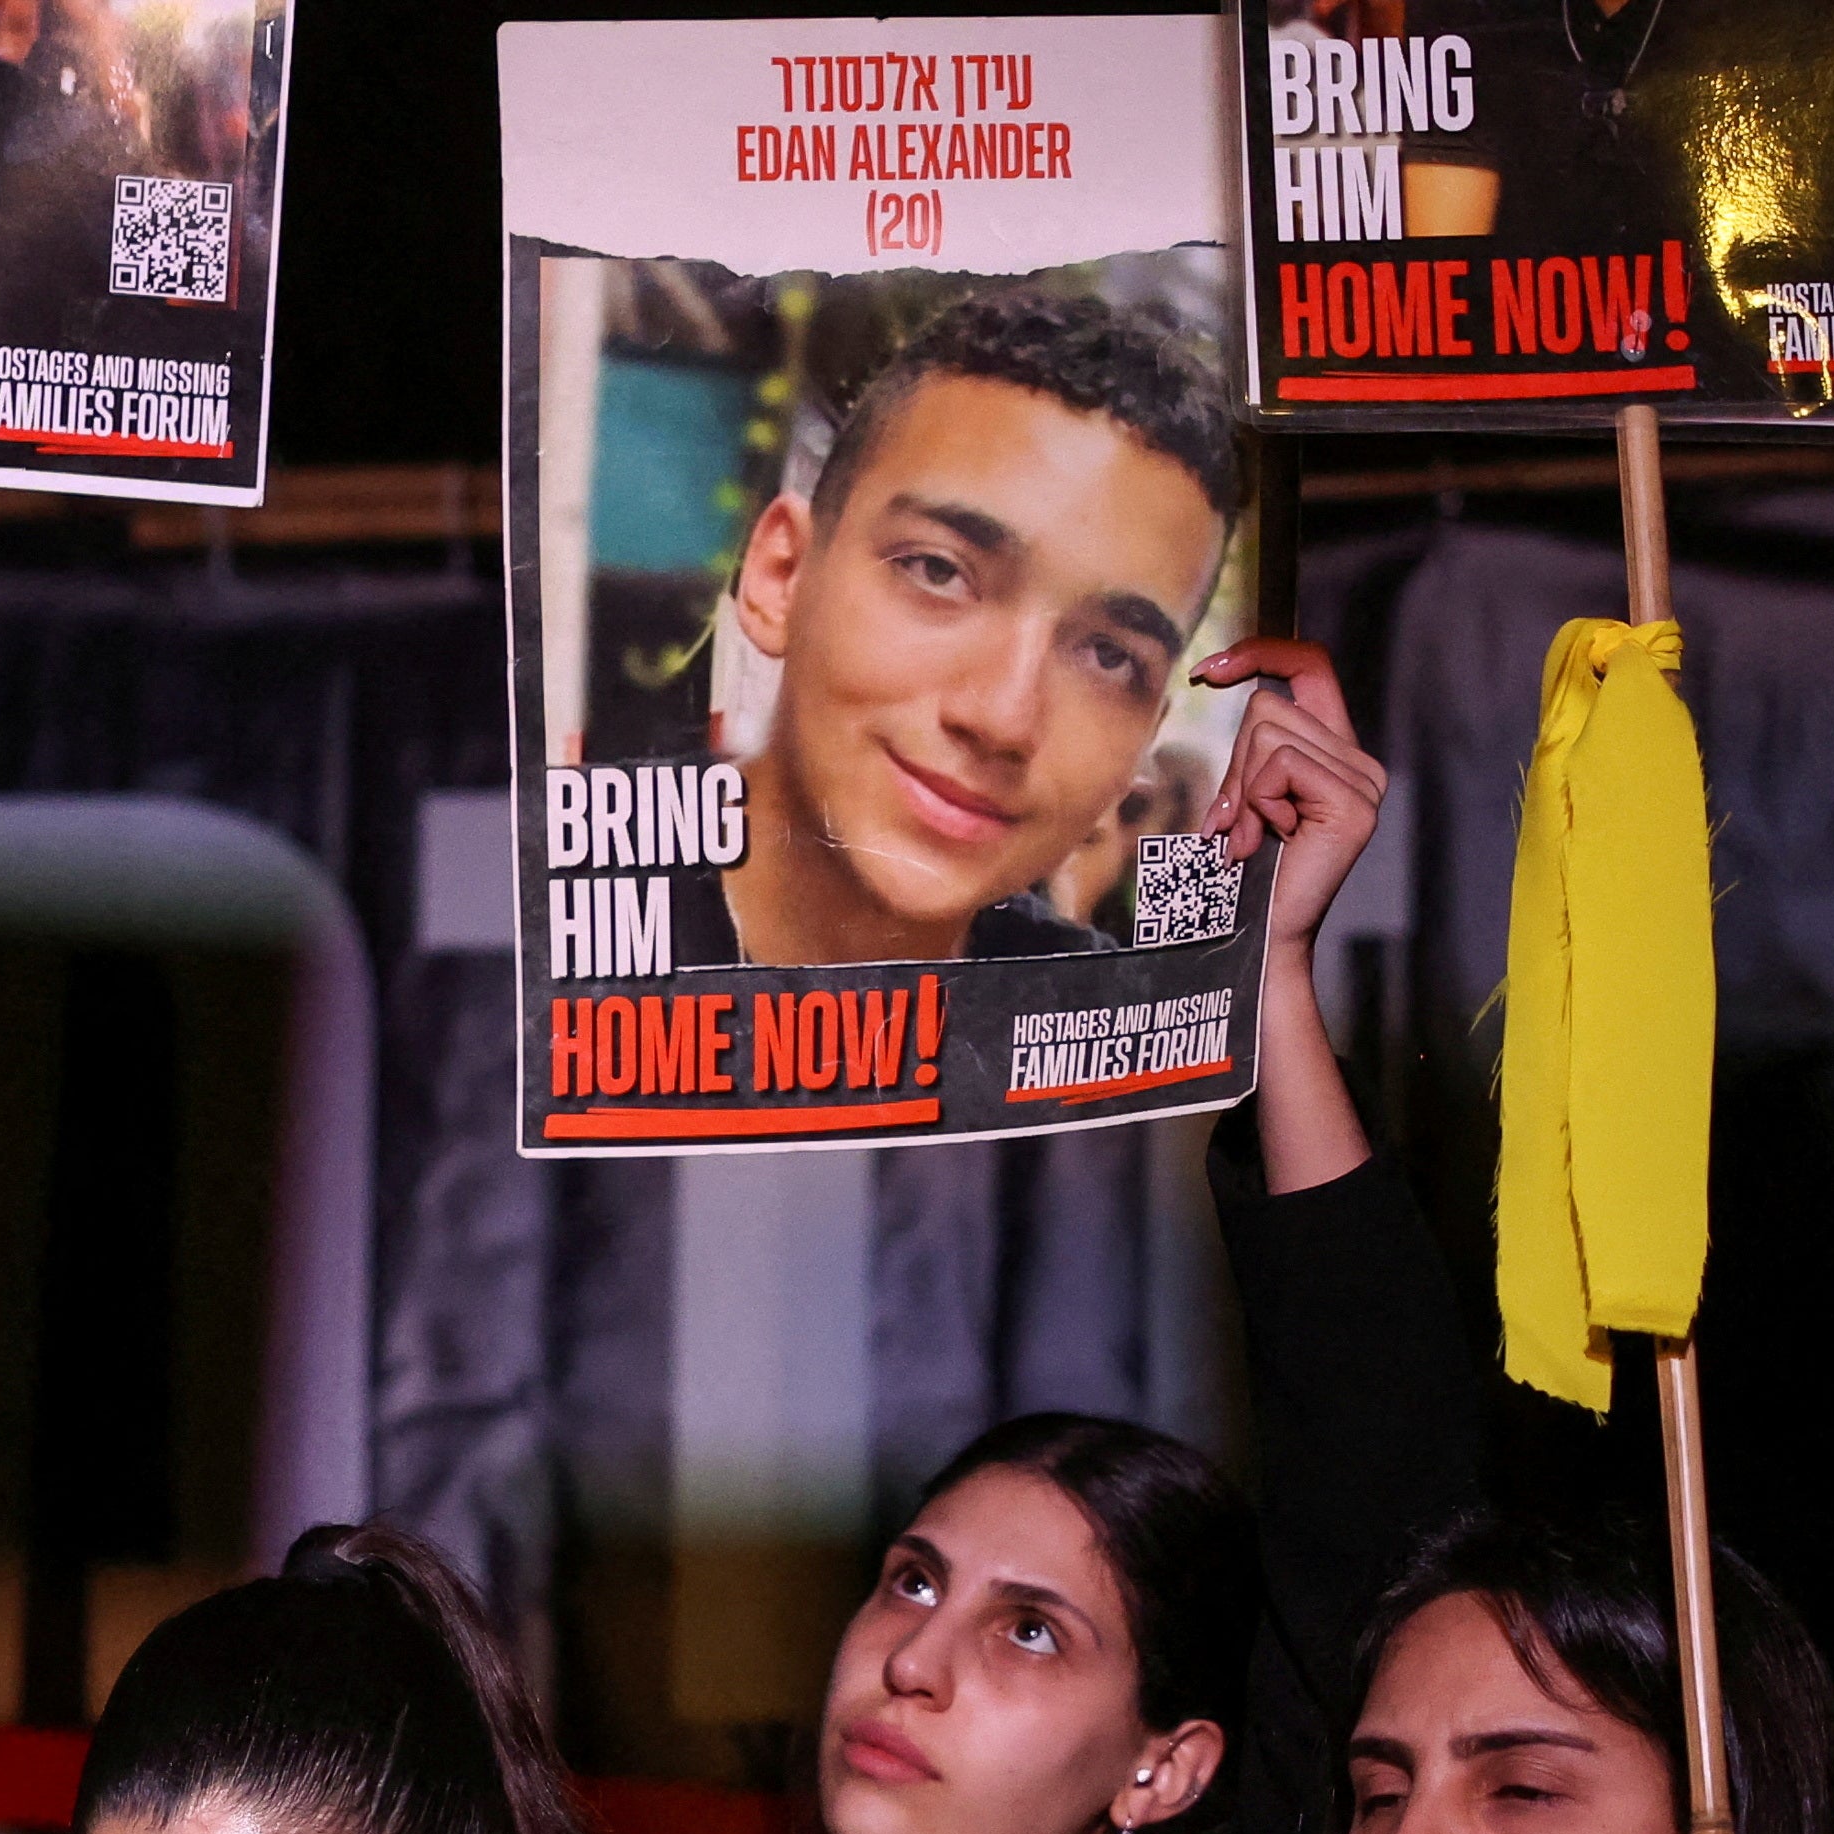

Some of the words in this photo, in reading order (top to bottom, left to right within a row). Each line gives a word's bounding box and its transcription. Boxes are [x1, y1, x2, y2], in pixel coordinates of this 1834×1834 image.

[771, 52, 937, 113] אלכסנדר
[951, 54, 1032, 118] עידן
[1271, 35, 1474, 136] BRING
[737, 124, 835, 182] EDAN
[849, 122, 1072, 181] ALEXANDER
[866, 190, 942, 256] (20)
[1276, 144, 1403, 243] HIM
[1279, 260, 1473, 358] HOME
[1491, 240, 1692, 356] NOW!
[91, 354, 134, 389] AND
[138, 358, 230, 396] MISSING
[121, 391, 228, 446] FORUM
[545, 764, 745, 869] BRING
[549, 876, 671, 979] HIM
[551, 995, 732, 1096] HOME
[754, 974, 948, 1090] NOW!
[1013, 1008, 1111, 1045] HOSTAGES
[1113, 1004, 1151, 1036] AND
[1154, 988, 1232, 1029] MISSING
[1010, 1037, 1132, 1091] FAMILIES
[1136, 1019, 1229, 1076] FORUM
